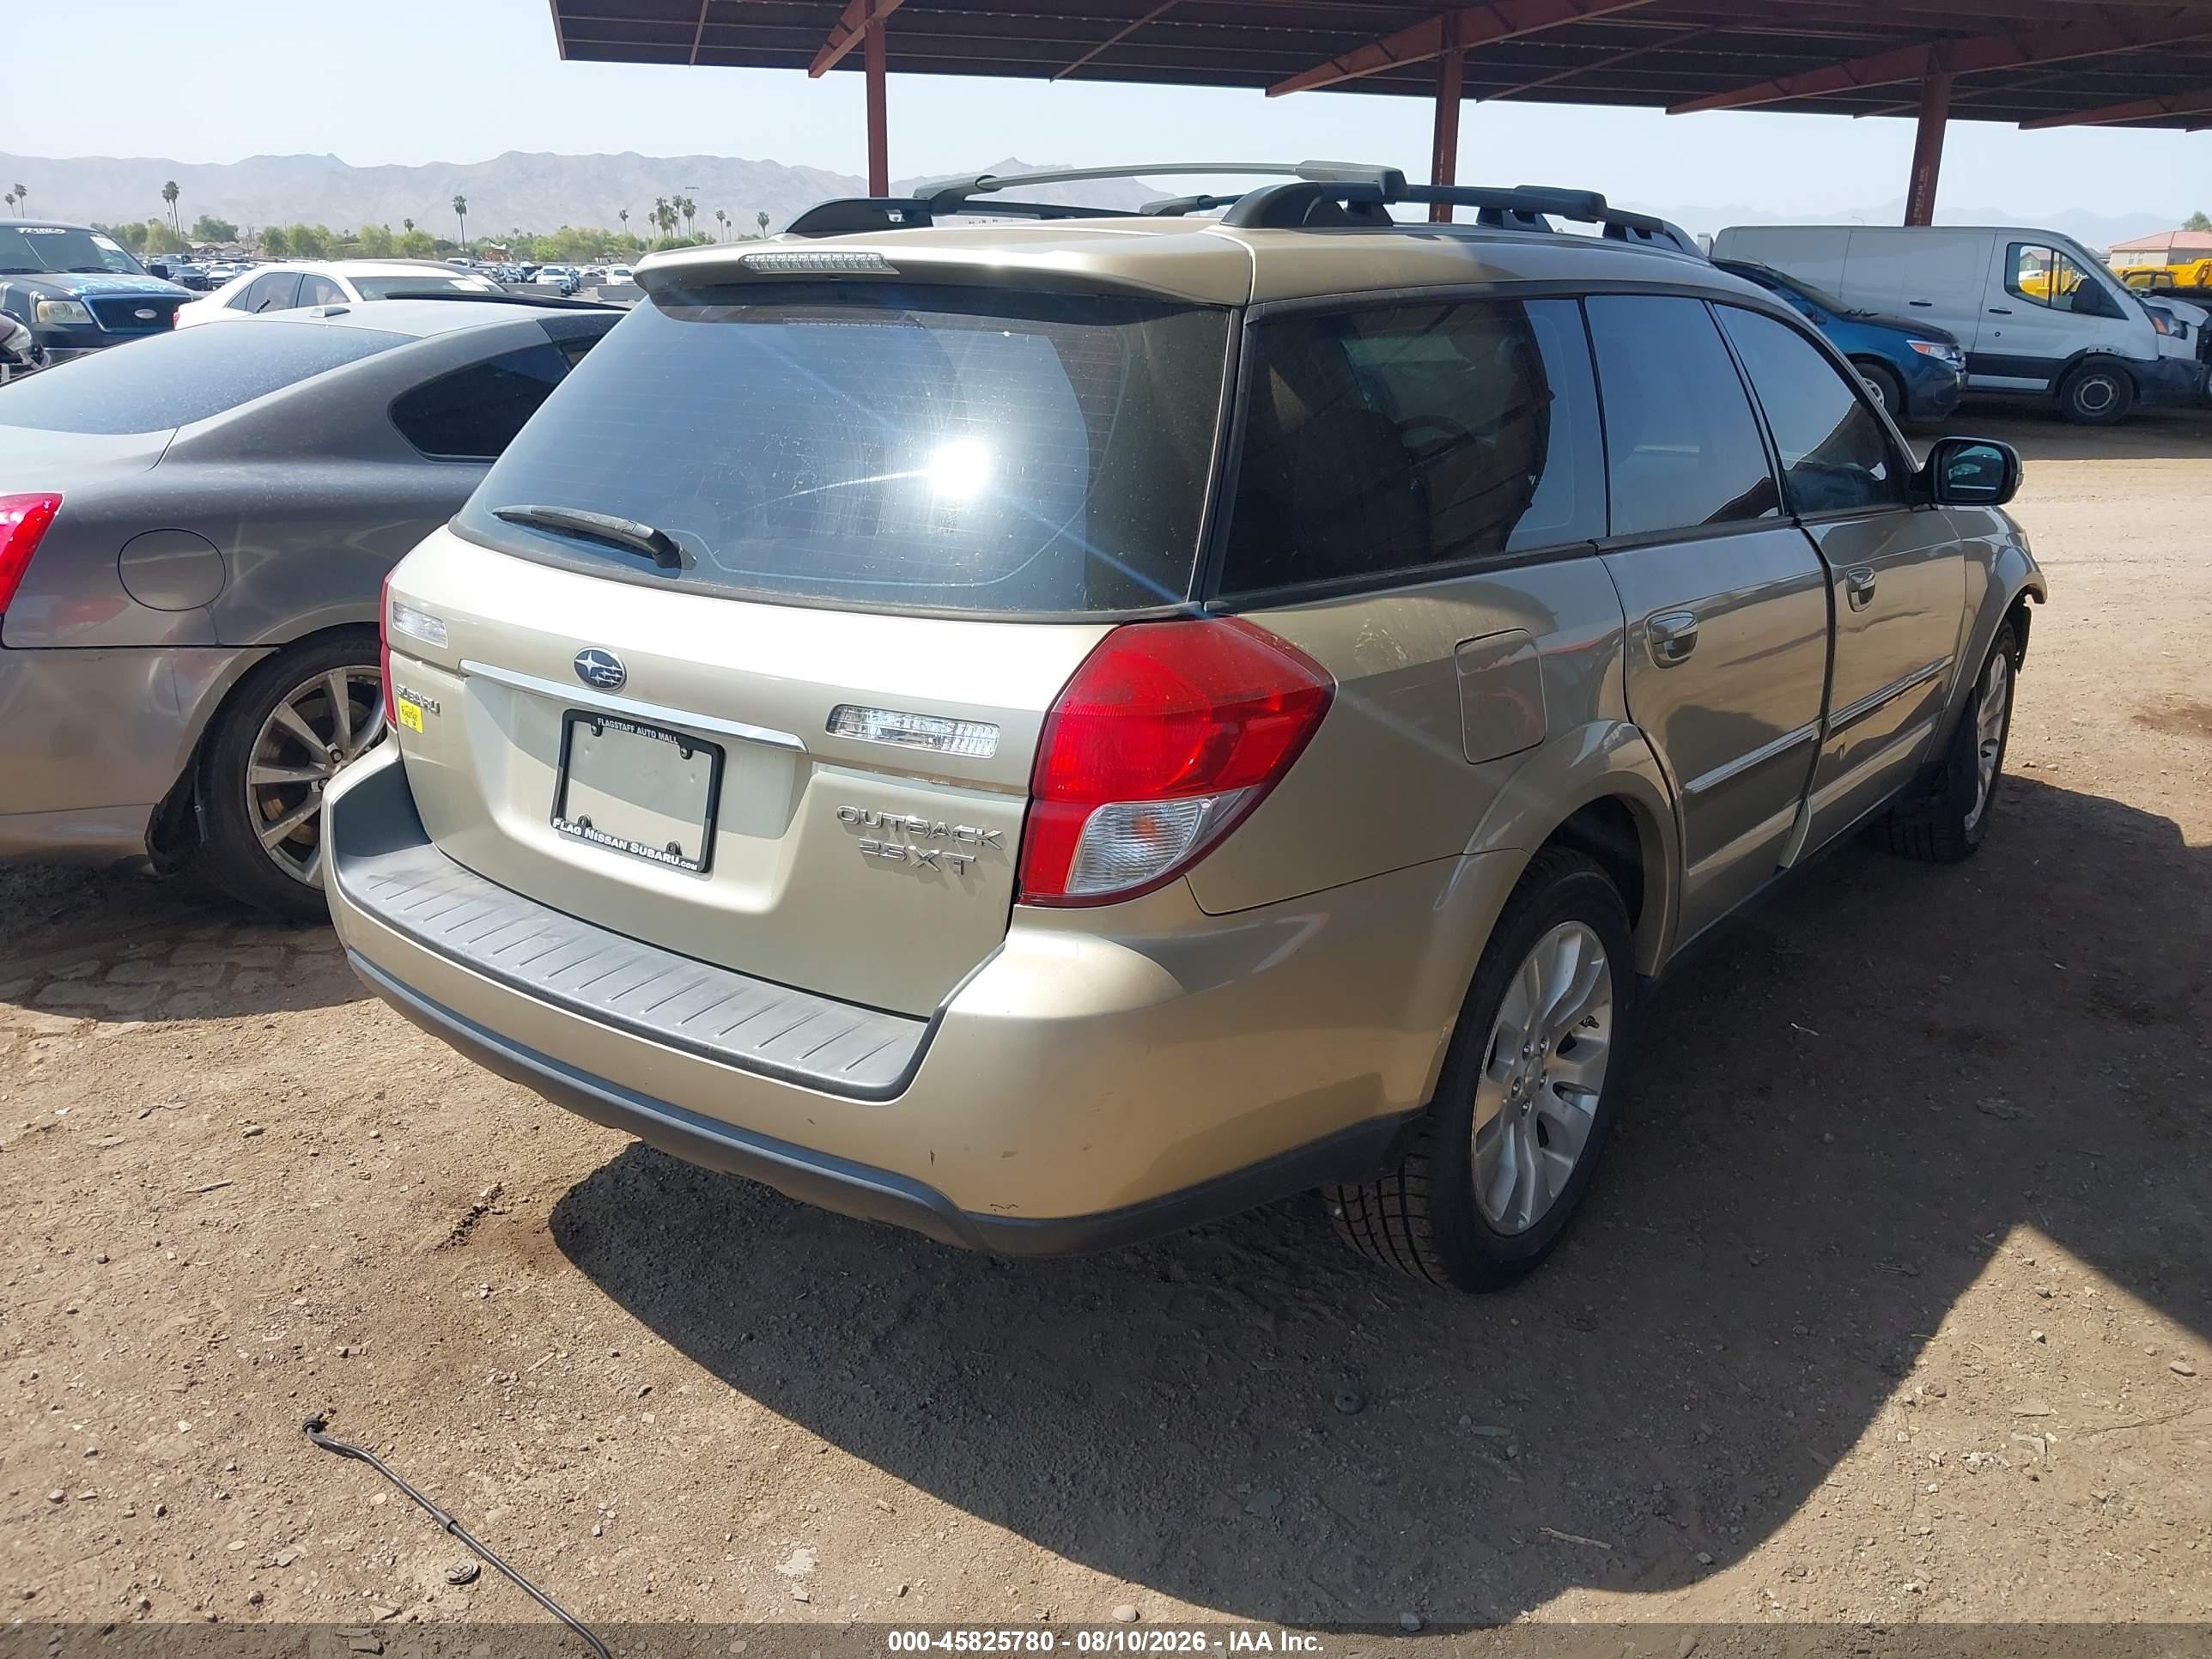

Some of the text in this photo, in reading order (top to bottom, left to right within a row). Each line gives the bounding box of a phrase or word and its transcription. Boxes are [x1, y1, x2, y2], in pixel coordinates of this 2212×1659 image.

[396, 684, 441, 714] SUBARU
[597, 718, 678, 744] FLAGSTAFF AUTO MALL
[552, 817, 581, 836] FLAG
[585, 828, 628, 850] NISSAN
[836, 805, 1003, 850] OUTBACK
